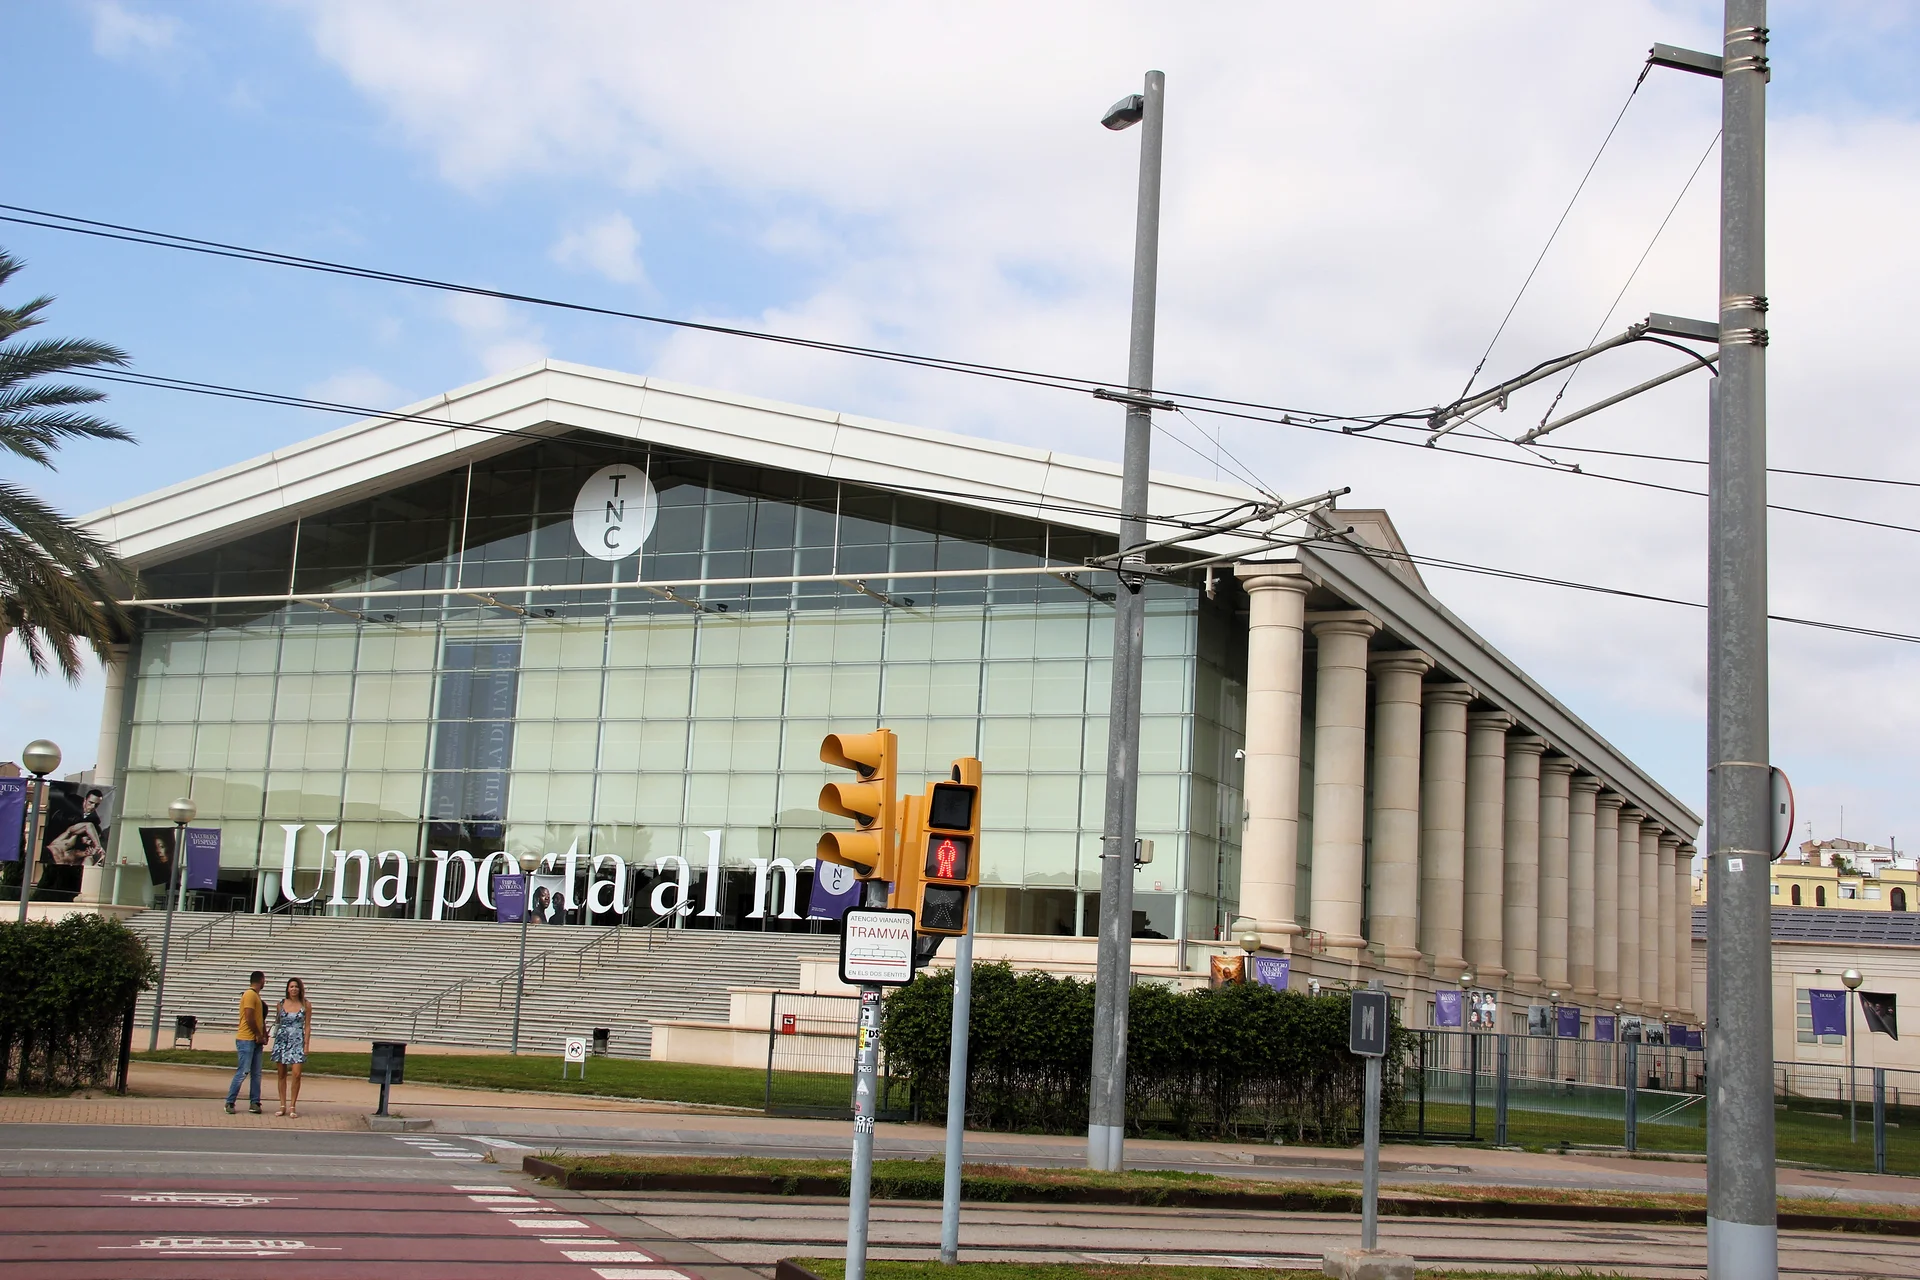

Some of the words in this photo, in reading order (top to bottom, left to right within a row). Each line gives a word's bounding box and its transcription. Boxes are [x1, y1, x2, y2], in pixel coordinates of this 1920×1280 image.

[280, 824, 412, 908] Una
[650, 829, 722, 917] al
[850, 915, 878, 923] ATENCIÓ
[879, 917, 910, 925] VIANANTS
[849, 926, 910, 940] TRAMVIA
[862, 993, 879, 1001] CNT
